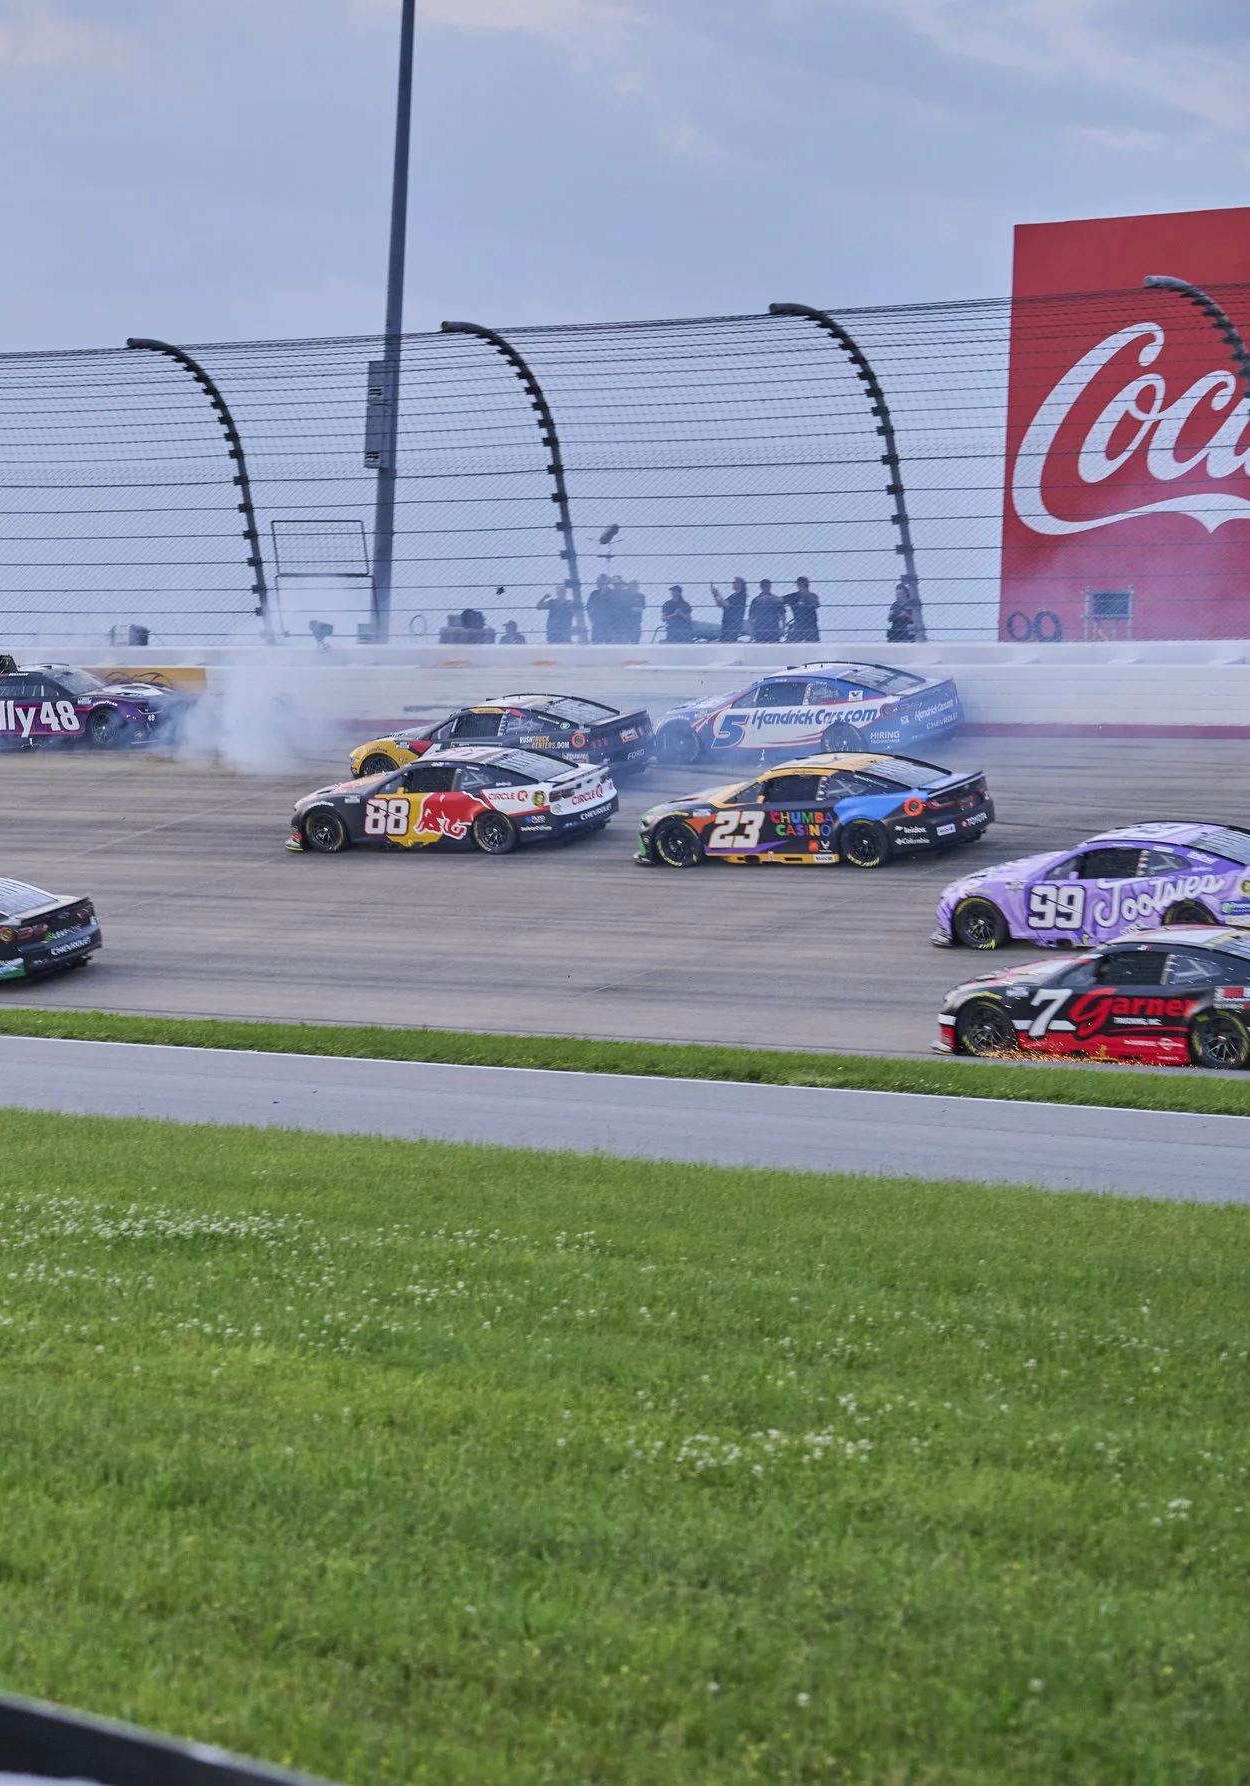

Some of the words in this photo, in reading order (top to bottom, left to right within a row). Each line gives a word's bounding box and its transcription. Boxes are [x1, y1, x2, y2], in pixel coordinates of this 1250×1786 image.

[40, 700, 81, 732] 48
[926, 712, 958, 730] CHEVROLET
[711, 714, 750, 749] 5
[870, 731, 900, 739] HIRING
[627, 748, 645, 761] FORD
[488, 792, 515, 801] CIRCLE
[365, 799, 410, 835] 88
[768, 811, 835, 824] CHUMBA
[709, 811, 765, 849] 23
[775, 824, 833, 837] CASINO
[1028, 884, 1086, 930] 99
[1028, 988, 1073, 1037] 7
